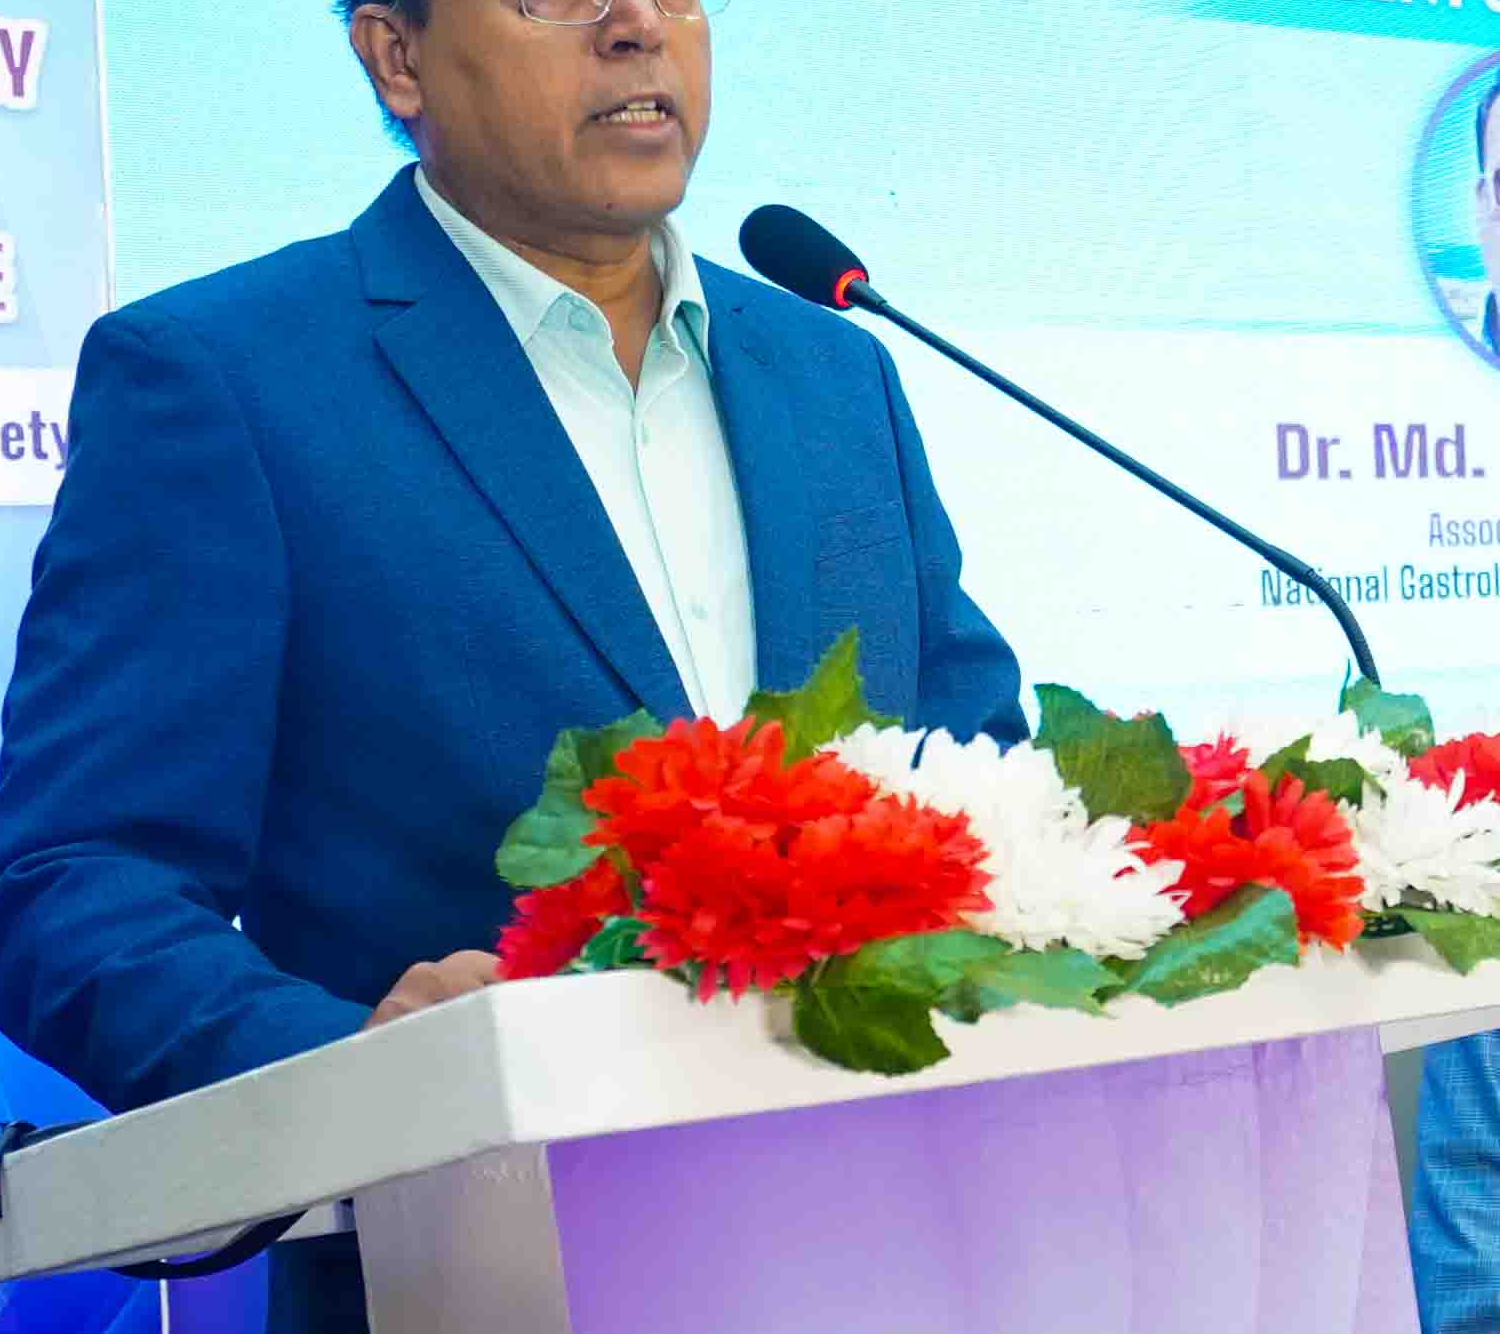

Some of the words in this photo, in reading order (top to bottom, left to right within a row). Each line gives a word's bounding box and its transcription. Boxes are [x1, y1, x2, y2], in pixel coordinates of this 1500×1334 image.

[1275, 421, 1352, 481] Dr.
[1372, 421, 1486, 480] Md.
[1260, 565, 1389, 606] Natonal
